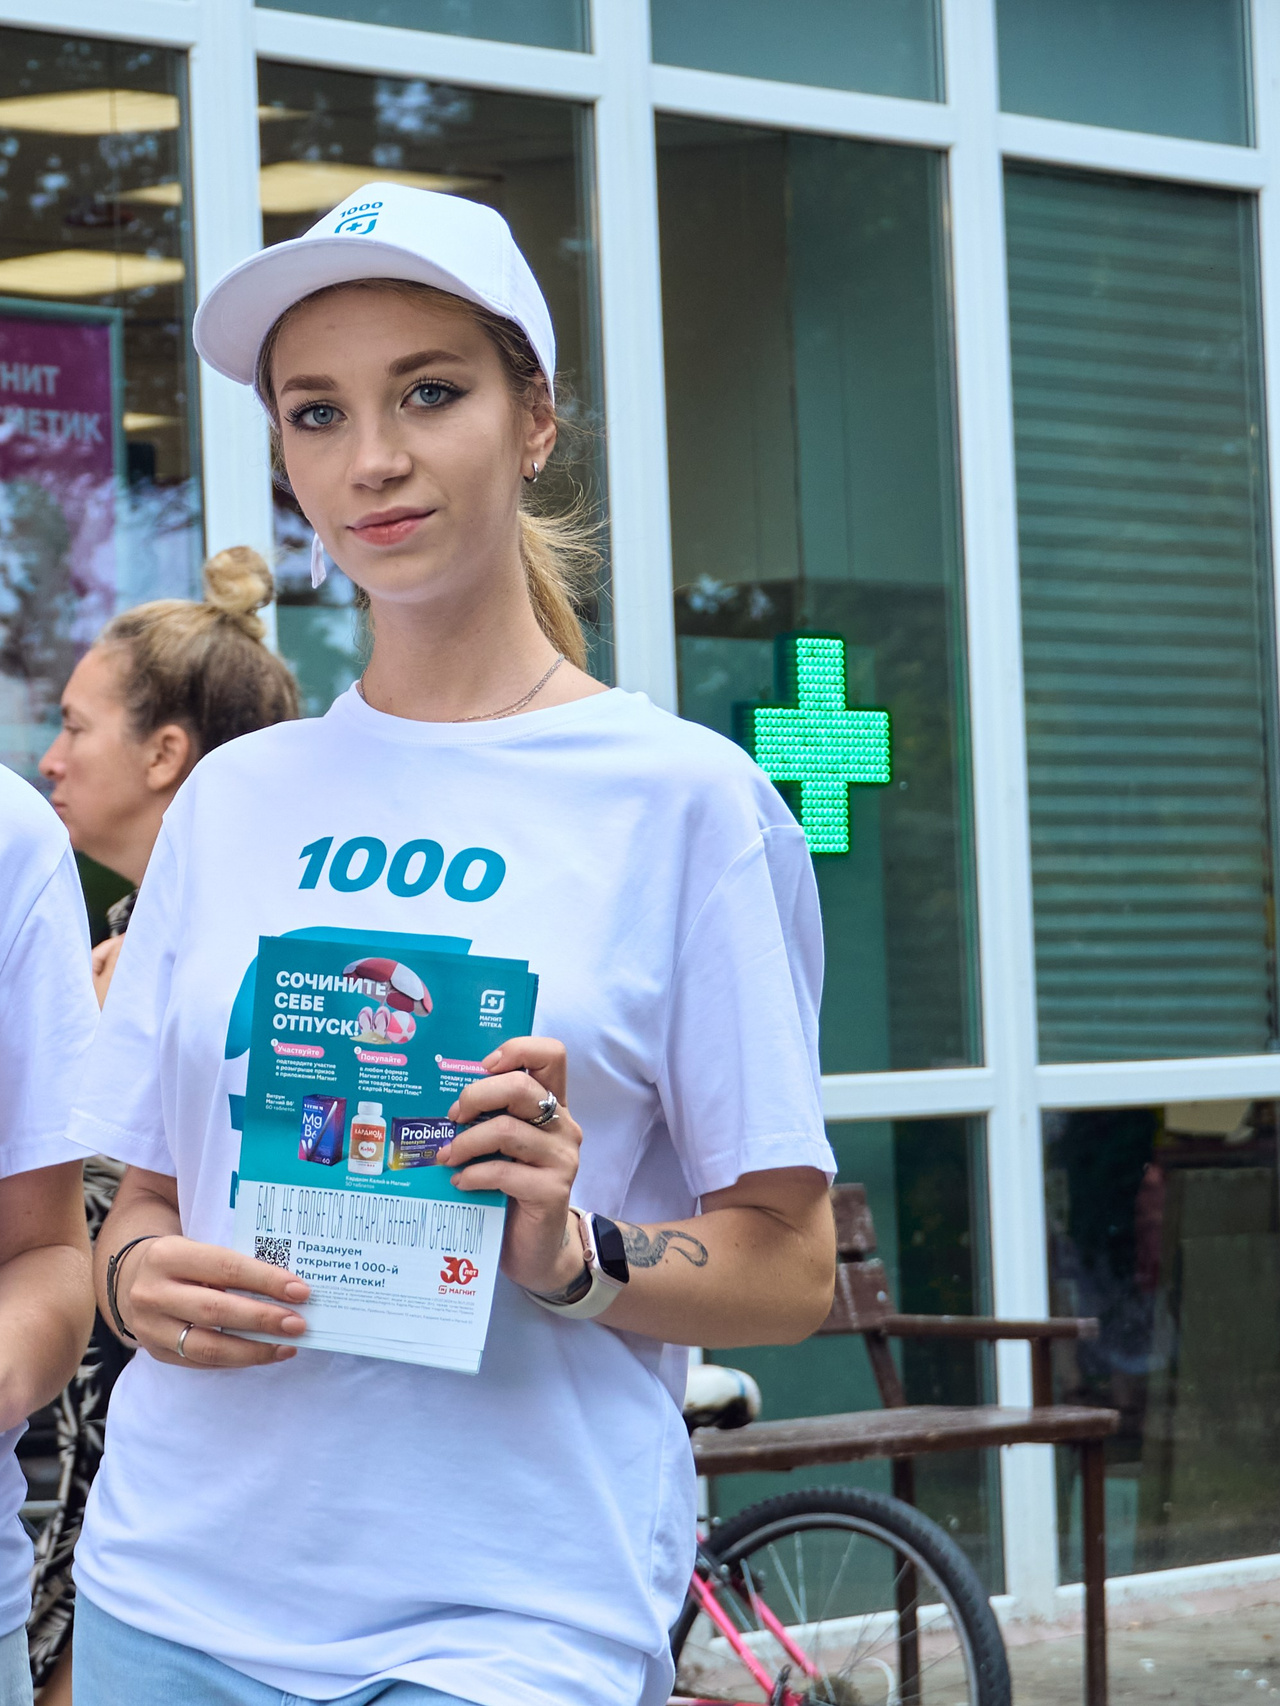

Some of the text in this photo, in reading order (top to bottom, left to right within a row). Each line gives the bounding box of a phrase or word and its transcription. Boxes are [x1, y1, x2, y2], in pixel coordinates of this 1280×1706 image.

[340, 201, 384, 218] 1000
[298, 836, 507, 903] 1000
[276, 970, 388, 996] СОЧИНИТЕ
[274, 992, 325, 1012] СЕБЕ
[272, 1013, 360, 1037] ОТПУСК!
[277, 1045, 320, 1056] Участвуйте
[360, 1053, 402, 1064] Покупайте
[276, 1059, 313, 1067] подтвердите
[280, 1072, 315, 1080] приложении
[266, 1092, 285, 1100] Витрум
[302, 1112, 323, 1129] Mg
[401, 1126, 454, 1140] Probielle
[280, 1188, 295, 1234] НЕ
[296, 1189, 345, 1240] ЯВЛЯЕТСЯ
[346, 1194, 428, 1248] ЛЕКАРСТВЕННЫМ
[429, 1202, 485, 1254] СРЕДСТВОМ
[297, 1240, 362, 1257] Празднуем
[296, 1257, 352, 1269] открытие
[440, 1256, 474, 1285] 30
[295, 1269, 386, 1287] Магнит Аптеки!
[449, 1288, 476, 1296] МАГНИТ
